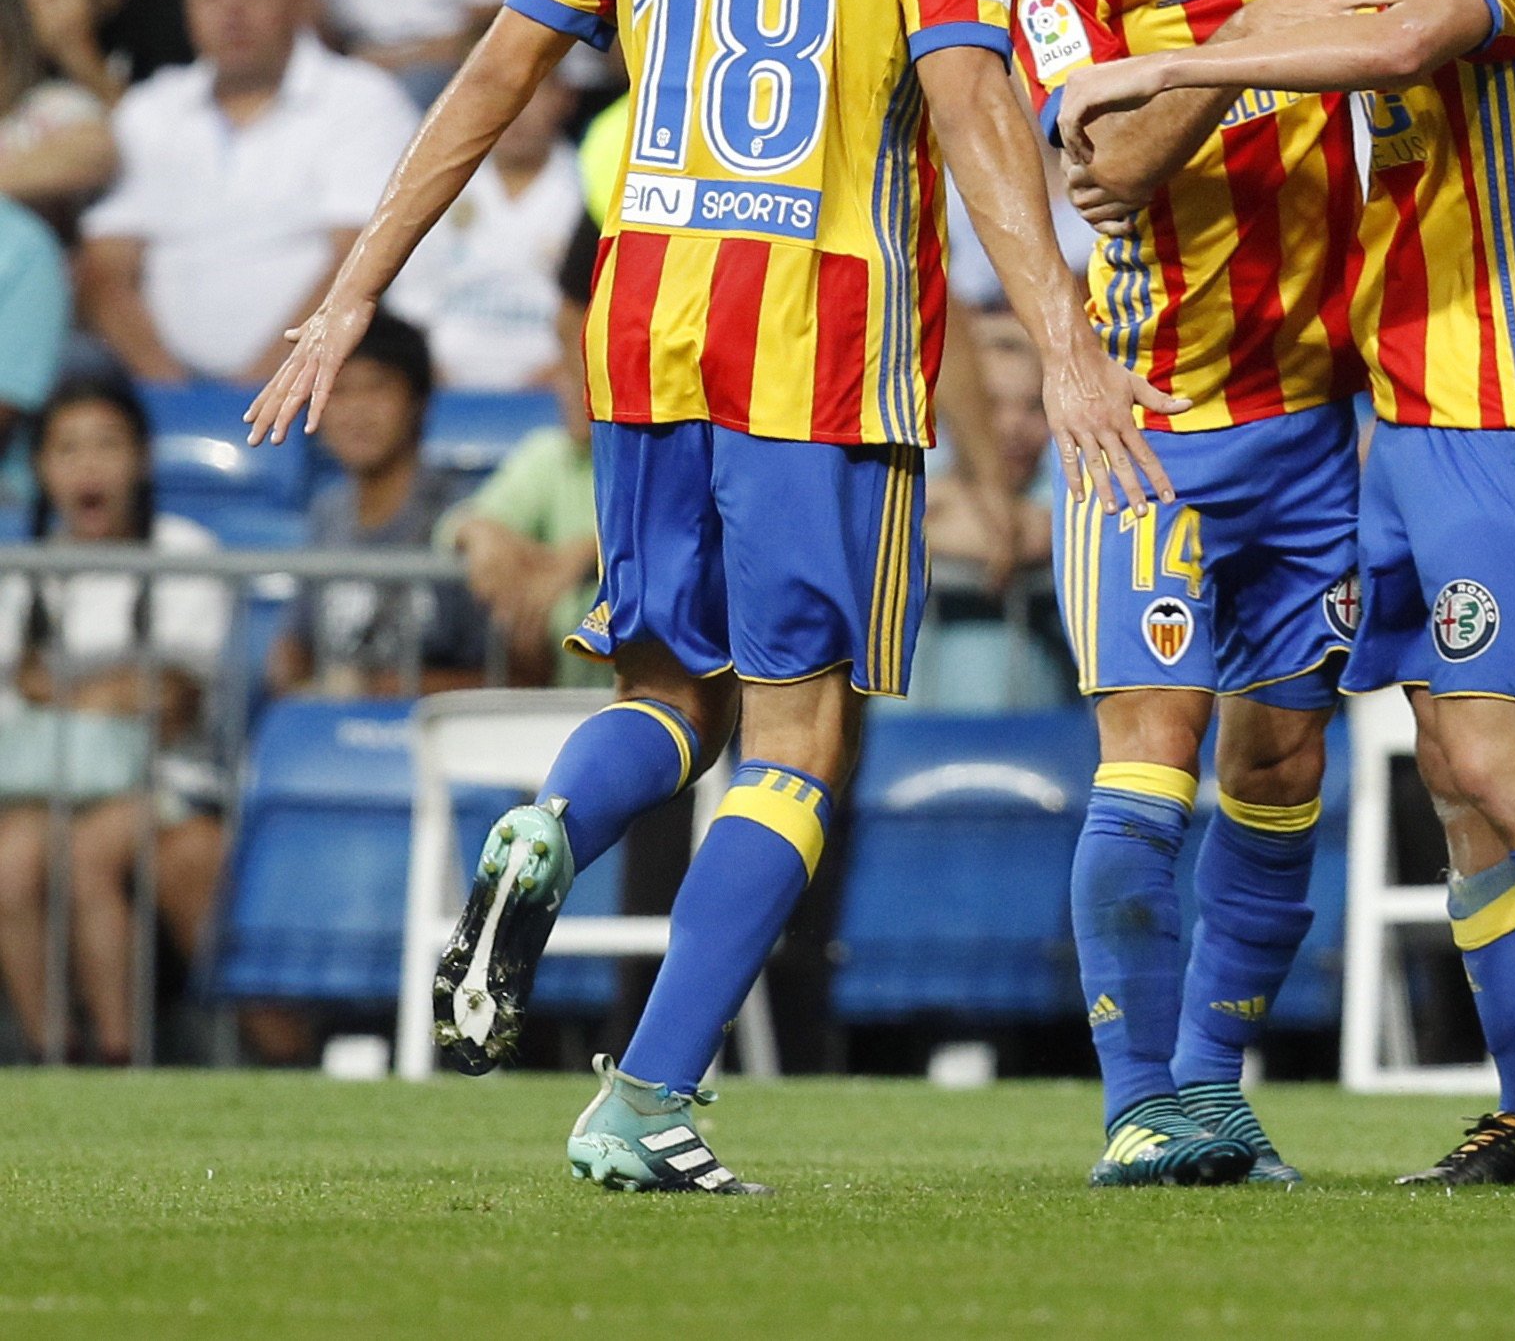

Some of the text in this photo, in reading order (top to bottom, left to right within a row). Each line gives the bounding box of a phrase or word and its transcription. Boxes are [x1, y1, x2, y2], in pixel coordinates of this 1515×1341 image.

[701, 190, 813, 229] SPORTS
[1119, 502, 1204, 599] 14
[1456, 583, 1496, 624] ROMEO
